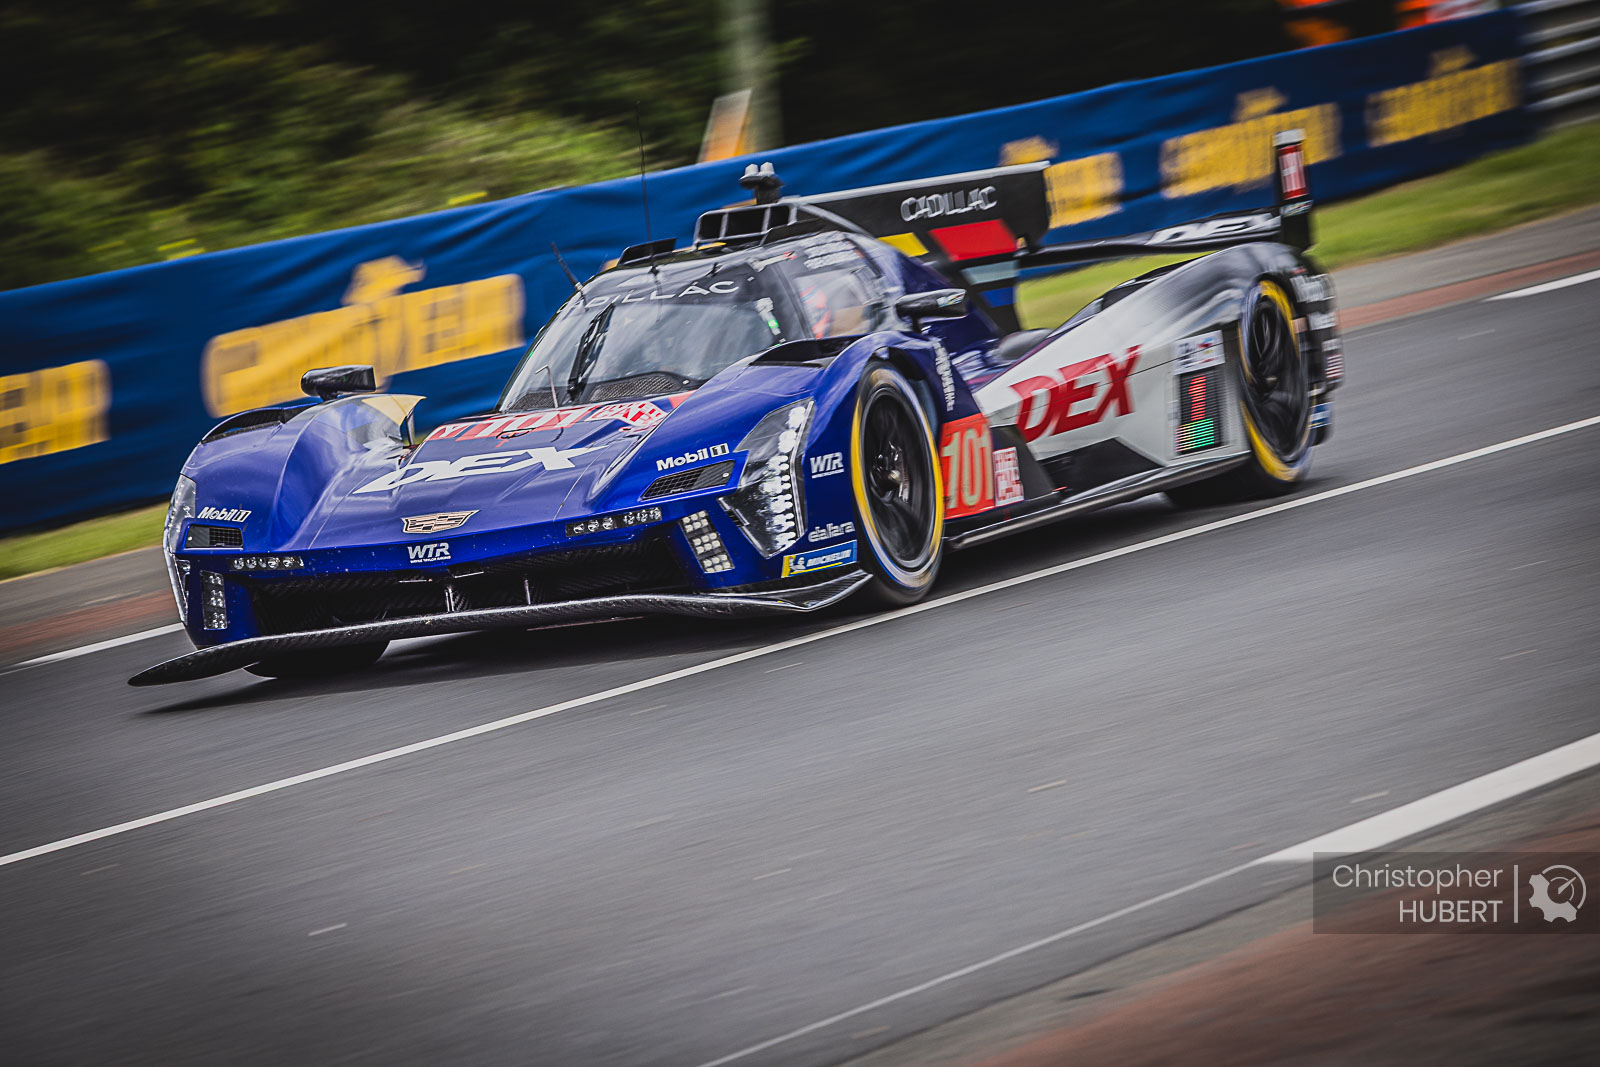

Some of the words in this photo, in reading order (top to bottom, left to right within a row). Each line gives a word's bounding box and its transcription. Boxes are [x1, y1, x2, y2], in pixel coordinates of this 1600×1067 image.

[900, 185, 998, 222] CADILLAC
[1009, 344, 1142, 443] DEX
[353, 446, 610, 494] DEX
[656, 447, 709, 471] Mobil
[810, 452, 844, 474] WTR
[942, 424, 994, 509] 101
[197, 506, 238, 521] Mobil
[407, 542, 450, 560] WTR
